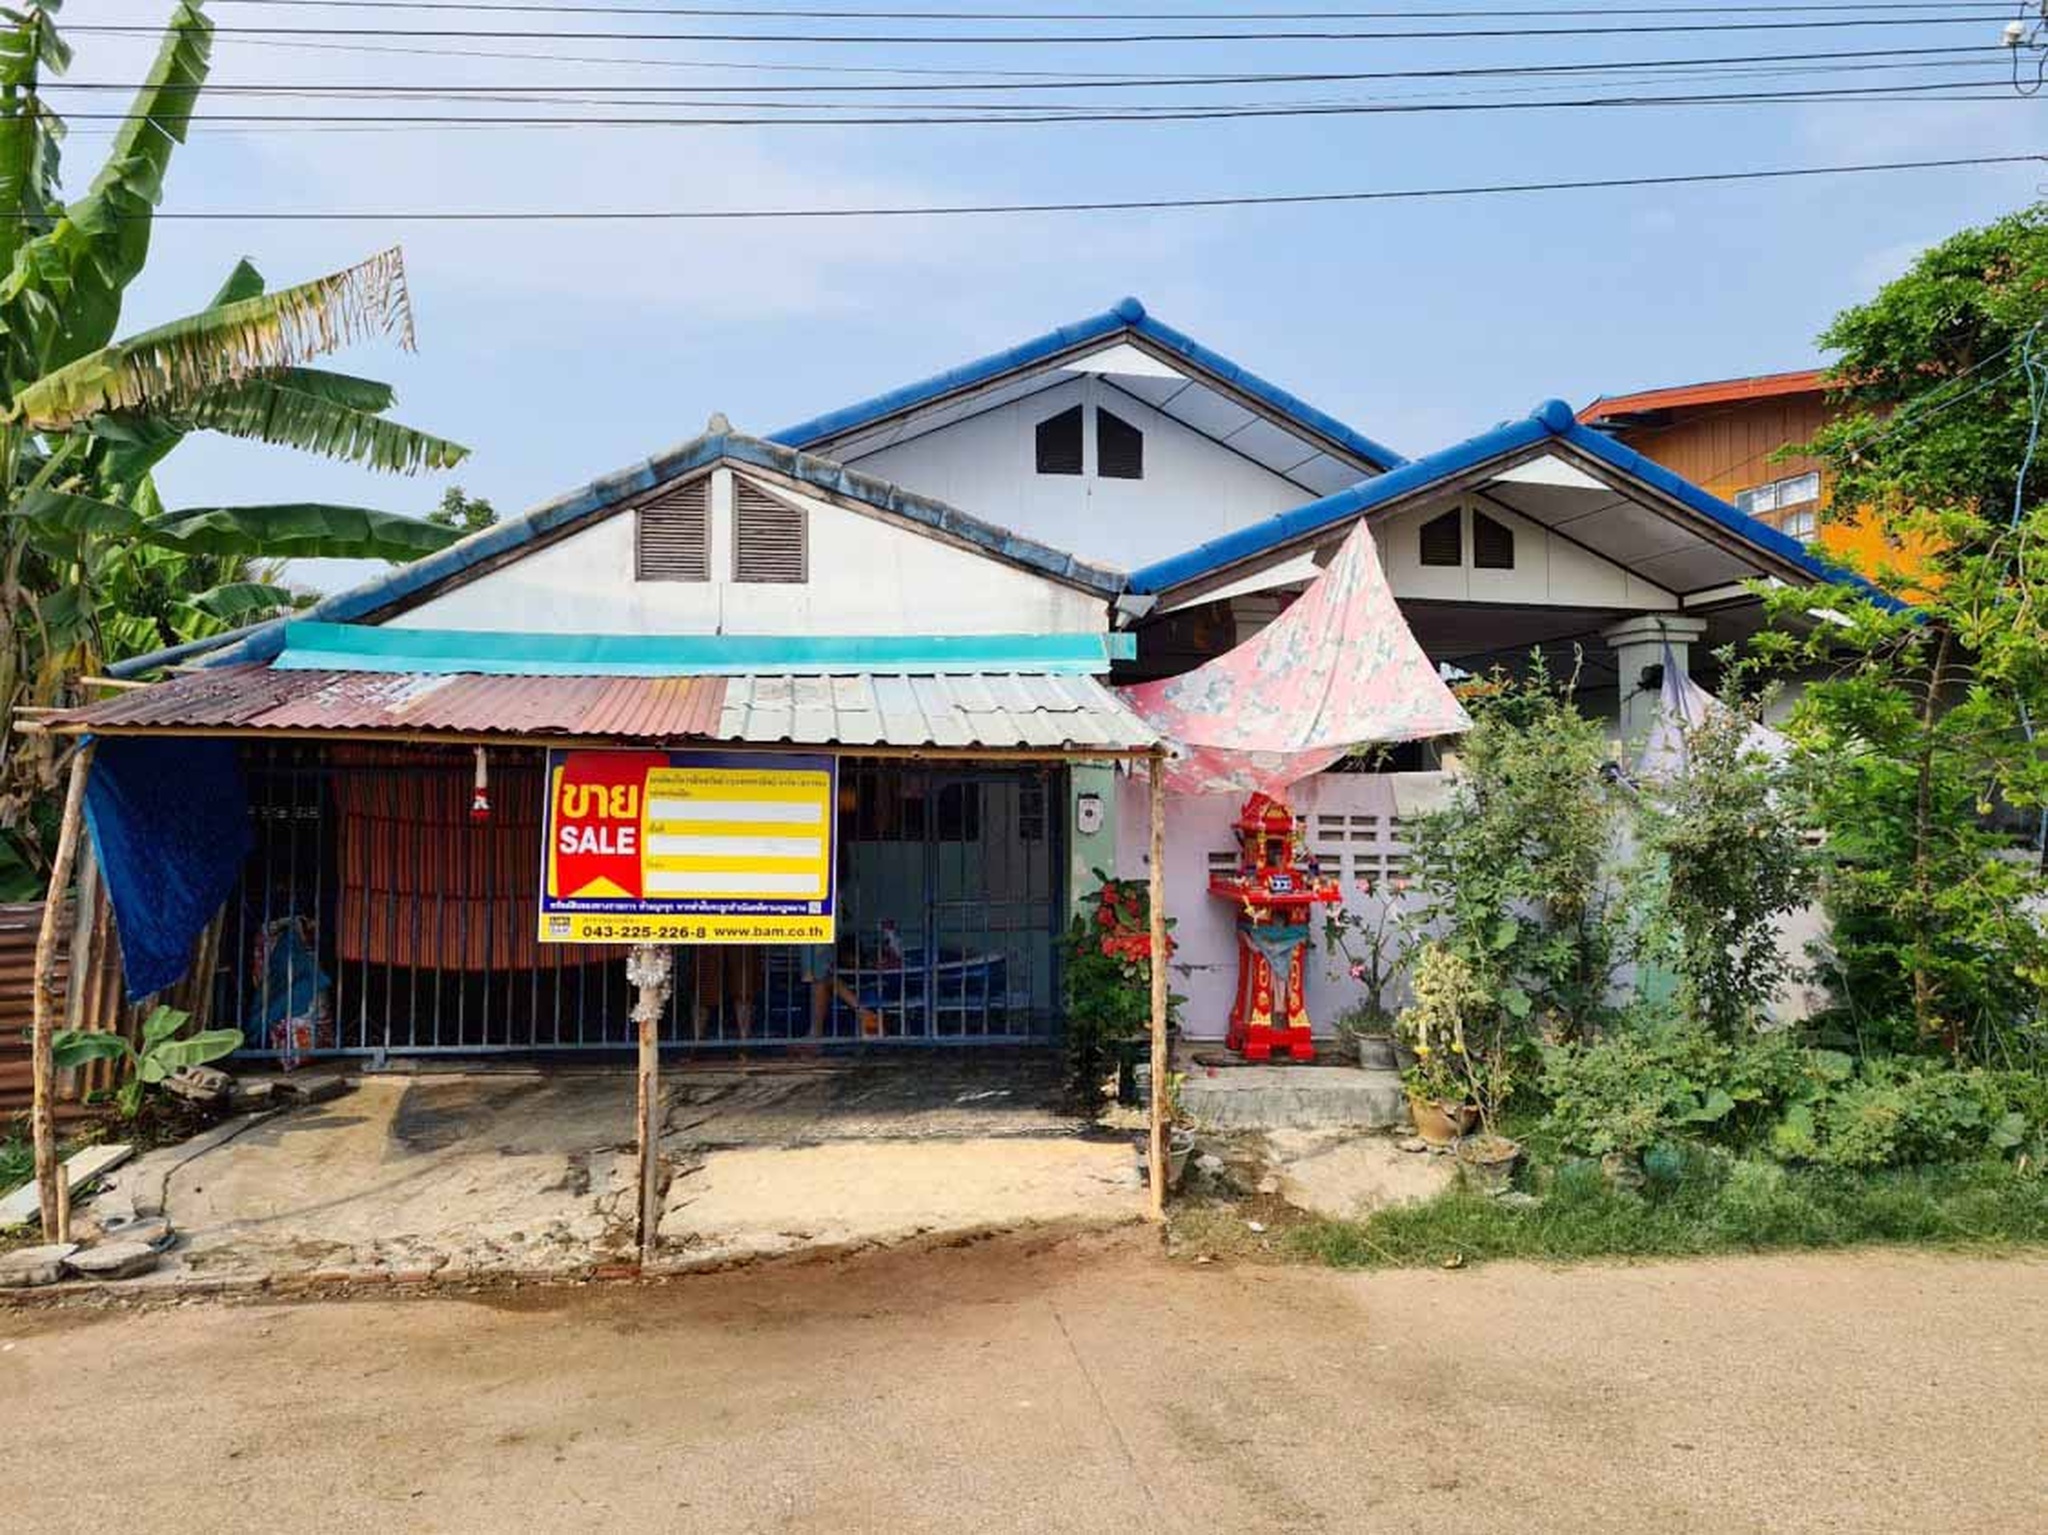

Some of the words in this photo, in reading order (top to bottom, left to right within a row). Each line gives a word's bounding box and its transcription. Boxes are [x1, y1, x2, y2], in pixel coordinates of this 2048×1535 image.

[562, 783, 638, 818] ขาย
[560, 826, 636, 855] SALE
[583, 926, 706, 938] 043-225-226-8
[714, 926, 823, 937] www.bam.co.th
